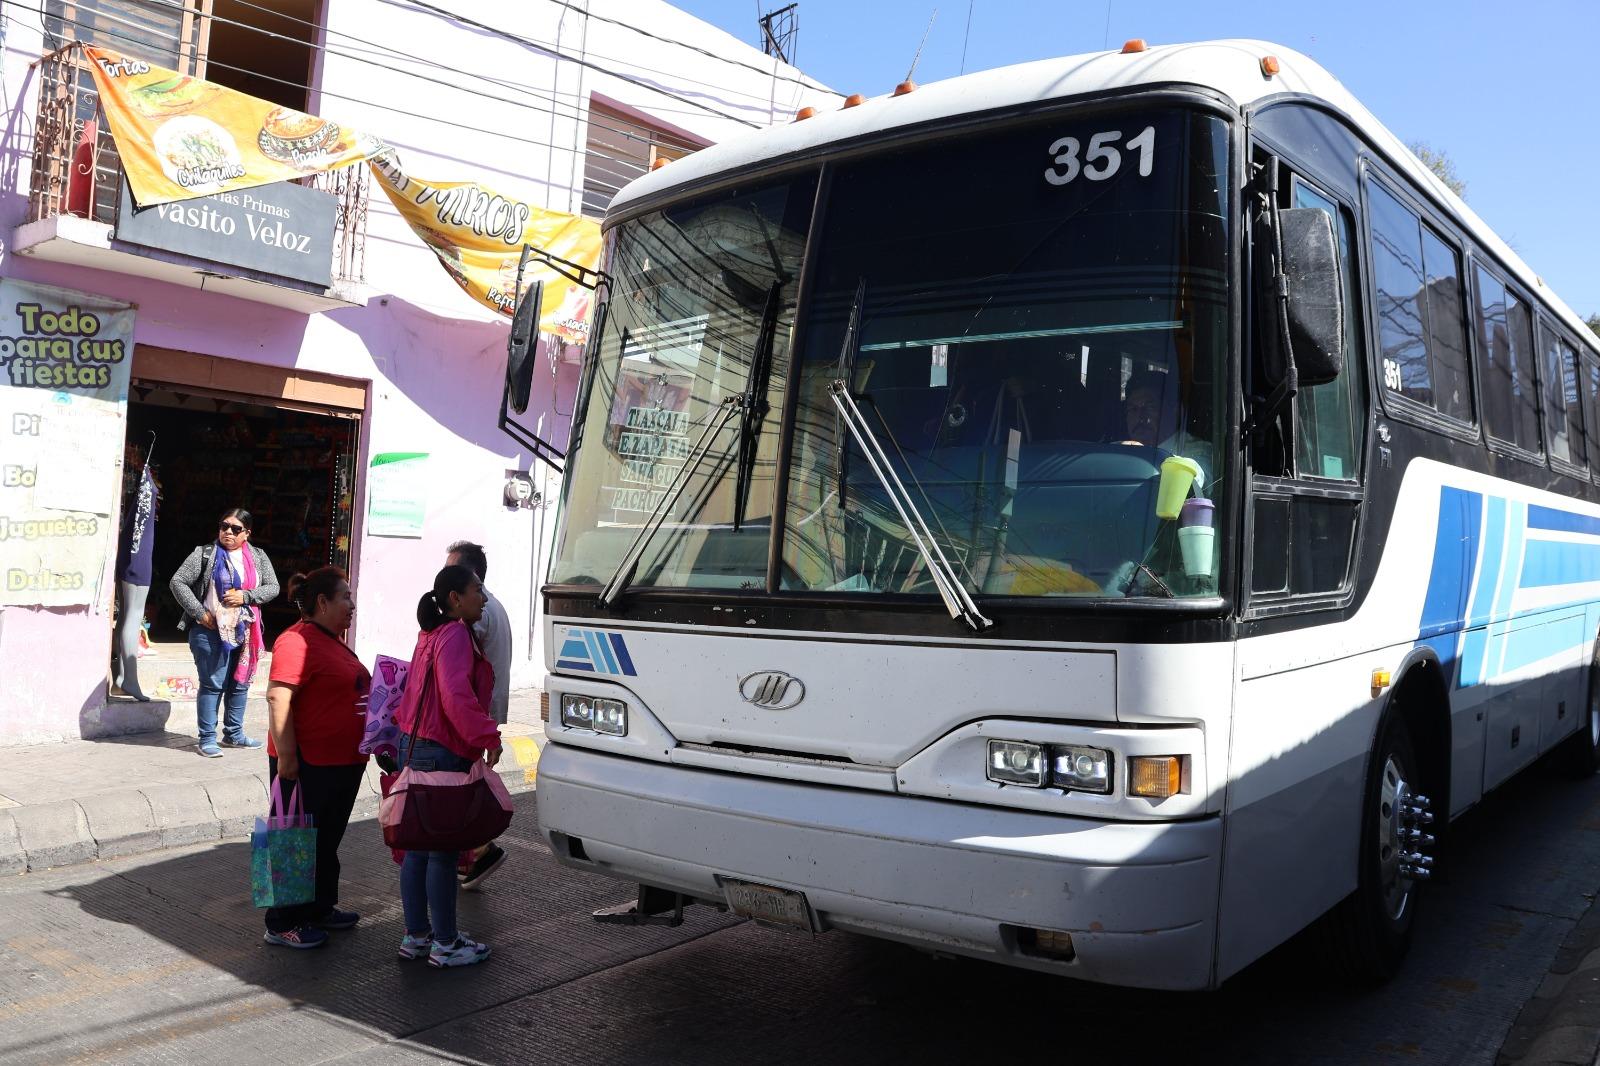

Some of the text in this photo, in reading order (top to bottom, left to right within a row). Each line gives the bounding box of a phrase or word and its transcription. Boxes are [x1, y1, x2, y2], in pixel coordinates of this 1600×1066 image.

[98, 58, 150, 78] Tortas
[1044, 125, 1156, 186] 351
[177, 161, 247, 187] Chilaquiles
[243, 194, 291, 219] Primas
[157, 202, 312, 254] Vasito Veloz
[16, 302, 100, 337] Todo
[0, 336, 125, 366] para sus
[8, 358, 111, 388] fiestas
[1383, 358, 1402, 392] 351
